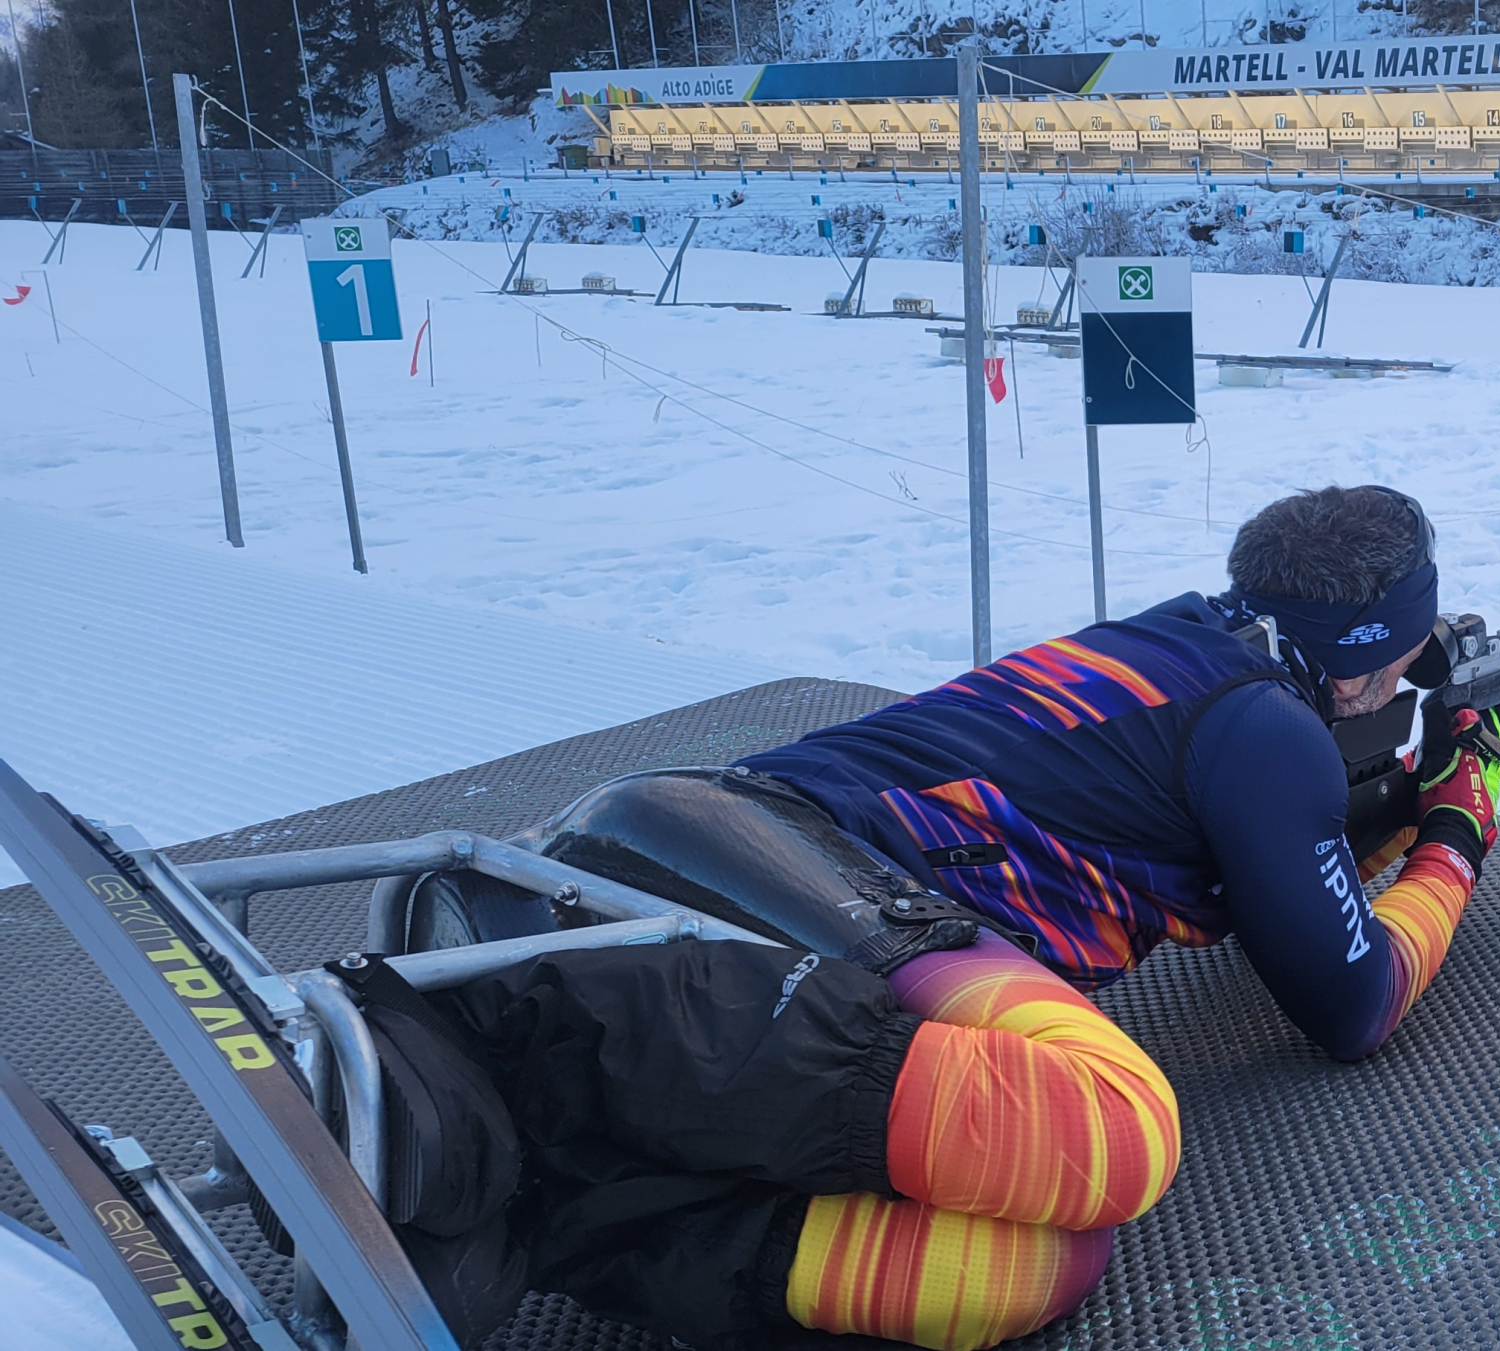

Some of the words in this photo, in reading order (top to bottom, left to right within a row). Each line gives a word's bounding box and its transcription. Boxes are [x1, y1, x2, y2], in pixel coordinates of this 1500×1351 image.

[1174, 52, 1289, 84] MARTELL
[1316, 49, 1366, 80] VAL
[982, 118, 991, 131] 22
[1036, 117, 1045, 130] 21
[1092, 117, 1102, 130] 20
[1150, 115, 1161, 129] 19
[1212, 114, 1222, 129] 18
[1275, 114, 1287, 129] 17
[1342, 112, 1355, 127] 16
[1413, 111, 1425, 126] 15
[1487, 110, 1499, 125] 14
[880, 120, 889, 132] 24
[930, 119, 939, 132] 23
[336, 264, 374, 336] 1
[1320, 852, 1371, 963] Audi
